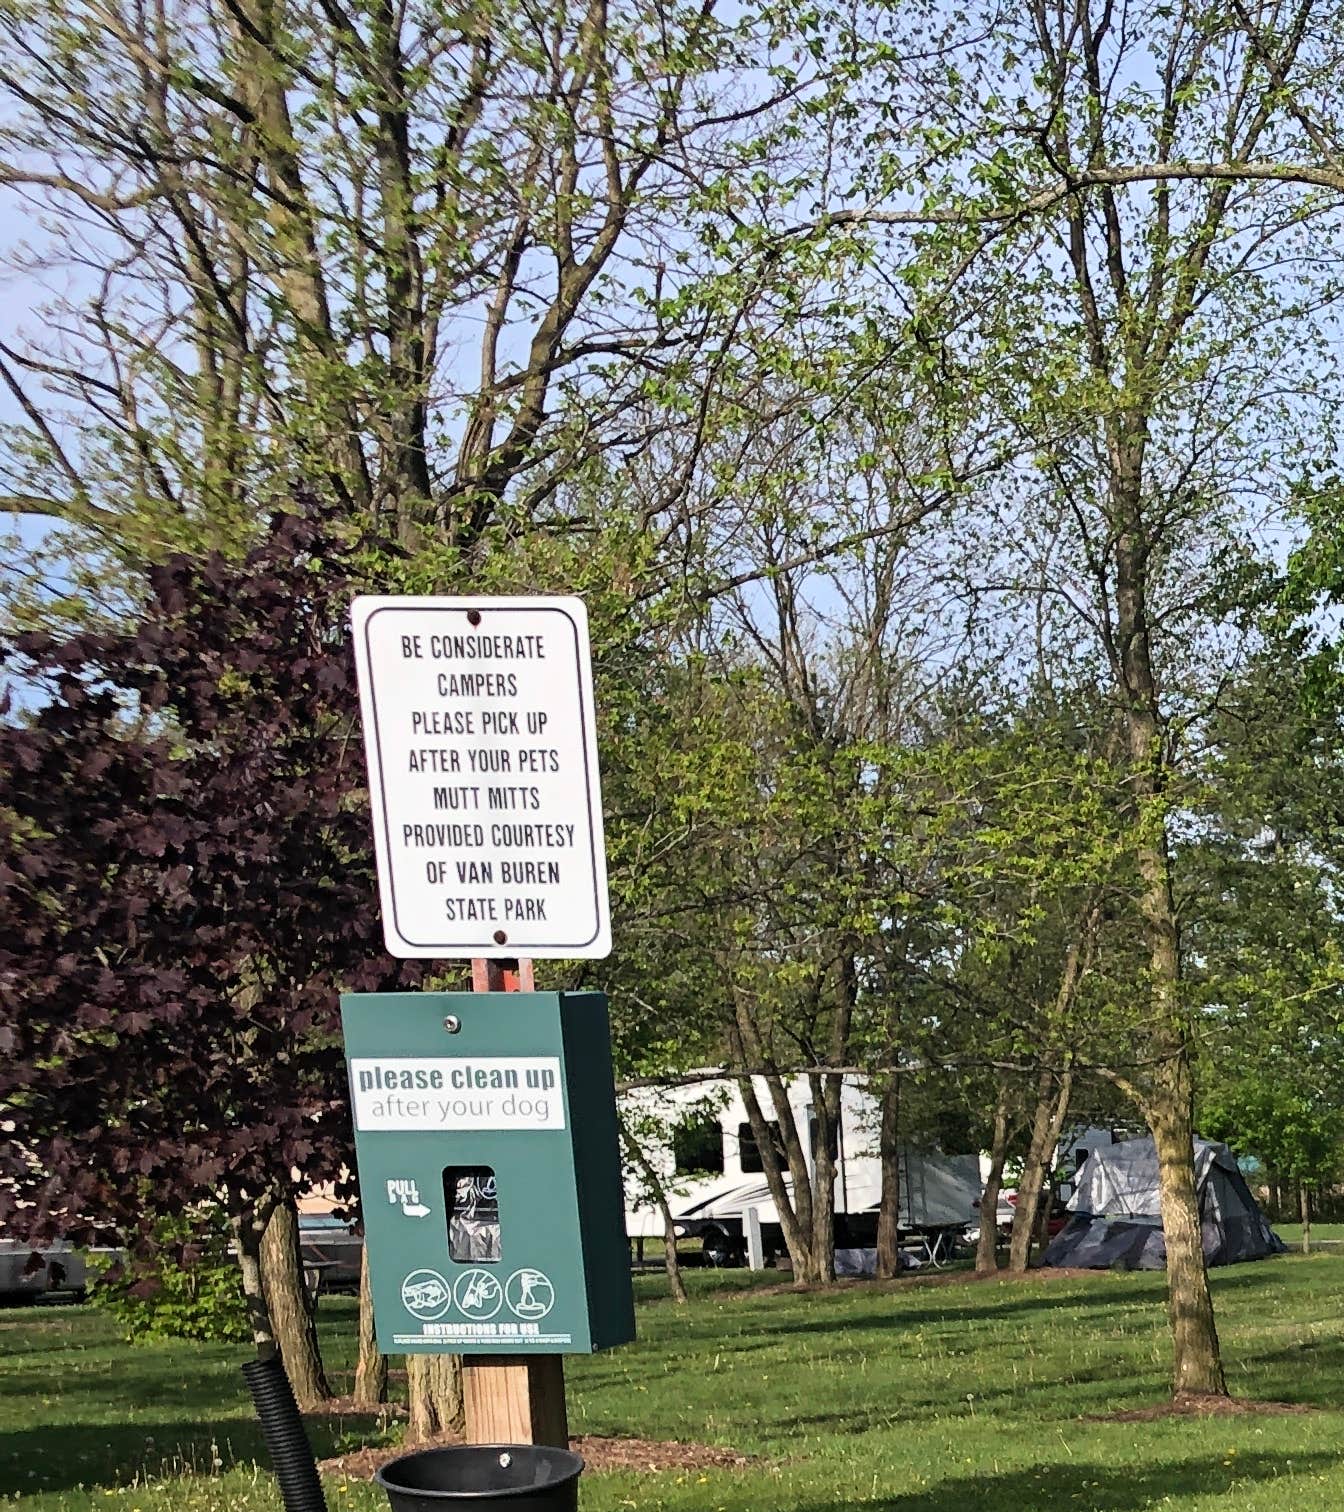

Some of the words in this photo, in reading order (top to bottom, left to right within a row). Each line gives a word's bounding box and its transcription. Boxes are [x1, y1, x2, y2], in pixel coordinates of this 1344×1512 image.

[402, 636, 423, 658] BE
[431, 636, 545, 659] CONSIDERATE
[438, 673, 517, 696] CAMPERS
[412, 712, 474, 734] PLEASE
[482, 712, 519, 734] PICK
[527, 712, 547, 734] UP
[409, 750, 460, 772] AFTER
[468, 749, 510, 772] YOUR
[519, 749, 559, 772] PETS
[434, 787, 479, 809] MUTT
[488, 787, 540, 810] MITTS
[403, 824, 483, 846] PROVIDED
[492, 824, 574, 847] COURTESY
[427, 861, 446, 884] OF
[456, 862, 492, 883] VAN
[501, 862, 559, 884] BUREN
[446, 898, 497, 920] STATE
[505, 899, 546, 920] PARK
[359, 1067, 443, 1091] please
[451, 1066, 518, 1089] clean
[526, 1069, 554, 1091] up
[372, 1094, 429, 1117] after
[438, 1098, 493, 1122] your
[502, 1094, 549, 1121] dog
[387, 1179, 415, 1195] PULL
[423, 1323, 496, 1335] INSTRUCTIONS
